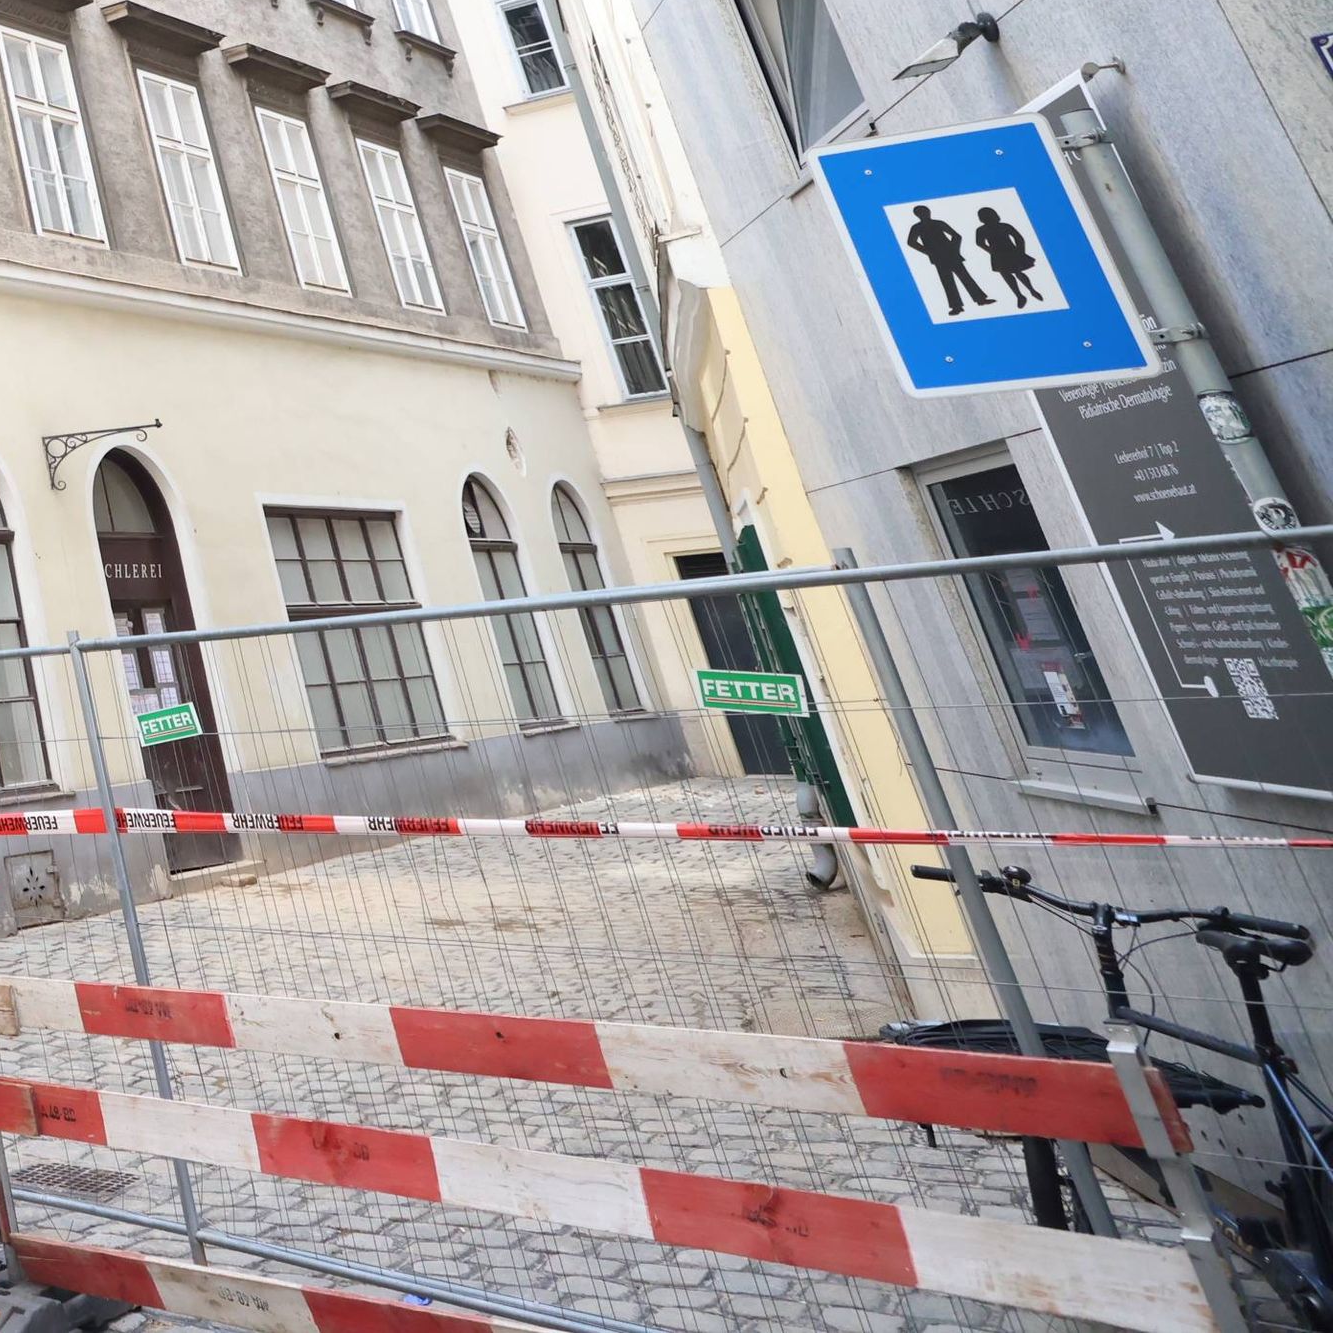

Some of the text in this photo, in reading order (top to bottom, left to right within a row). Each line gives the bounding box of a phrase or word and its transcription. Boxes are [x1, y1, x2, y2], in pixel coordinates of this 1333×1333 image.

[1119, 382, 1173, 409] Dermatologie
[1158, 443, 1173, 458] Top
[701, 678, 796, 702] FETTER
[141, 711, 193, 735] FETTER
[233, 814, 304, 830] FEUERWEHR
